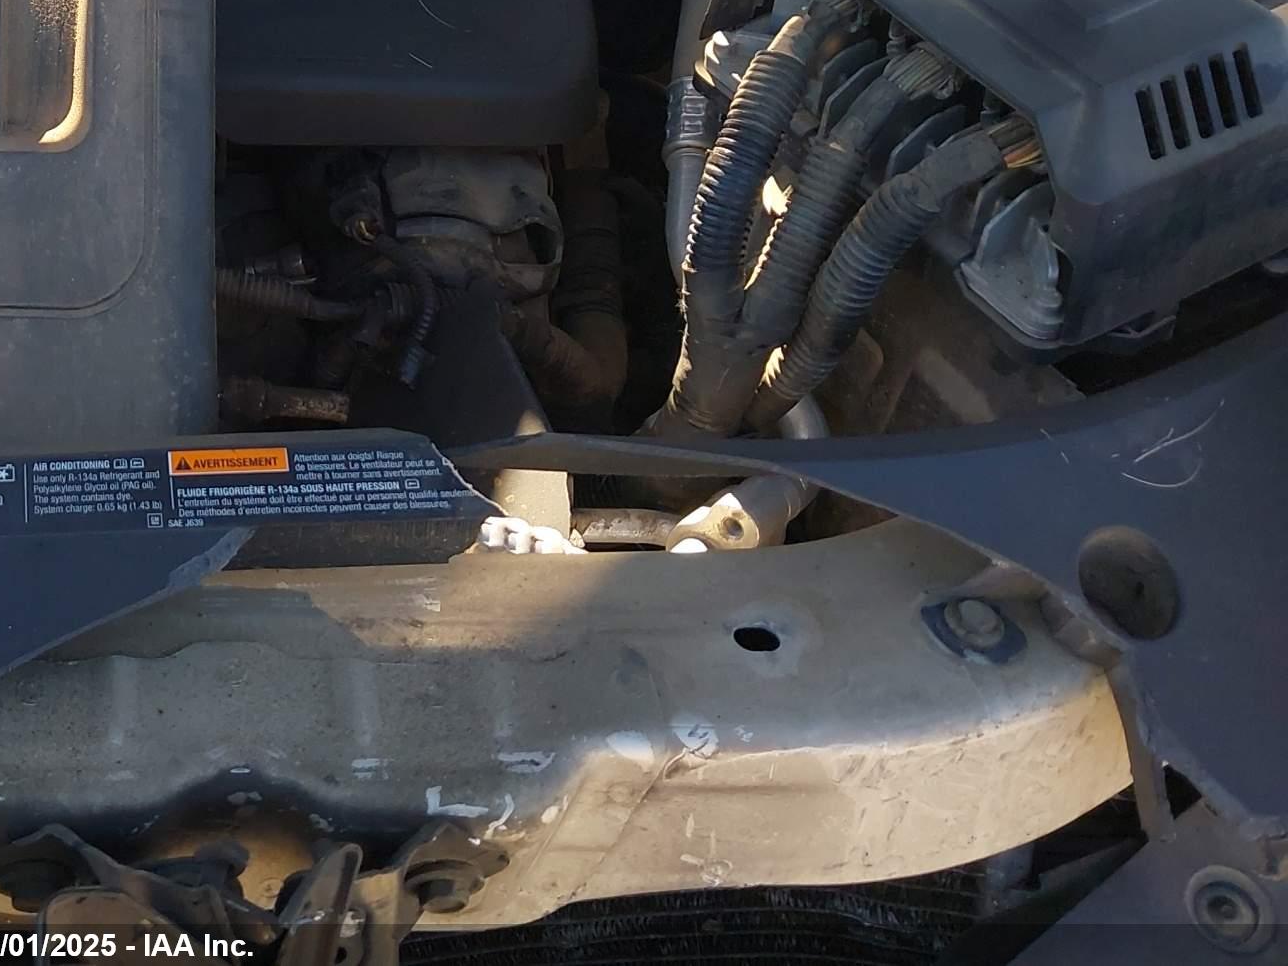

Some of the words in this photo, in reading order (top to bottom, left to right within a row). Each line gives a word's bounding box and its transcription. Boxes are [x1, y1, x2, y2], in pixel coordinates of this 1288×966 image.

[193, 456, 279, 469] AVERTISSEMENT
[294, 453, 330, 462] Attention
[377, 451, 404, 461] Risque
[33, 463, 48, 472] AIR
[50, 460, 110, 471] CONDITIONING
[295, 463, 305, 471] de
[307, 461, 346, 471] blessures.
[349, 461, 359, 470] Le
[362, 460, 403, 469] ventilateur
[406, 459, 423, 468] peut
[33, 474, 48, 483] Use
[50, 474, 66, 483] only
[69, 473, 97, 482] R-134a
[100, 471, 143, 481] Refrigerant
[145, 470, 160, 479] and
[296, 472, 322, 481] mettre
[332, 470, 360, 479] tourner
[33, 484, 82, 493] Polyalkylene
[84, 482, 108, 492] Glycol
[110, 482, 119, 490] oil
[121, 481, 139, 491] (PAG
[177, 487, 207, 498] FLUIDE
[209, 484, 266, 496] FRIGORIGÈNE
[268, 485, 298, 494] R-134a
[301, 484, 324, 493] SOUS
[326, 483, 354, 492] HAUTE
[356, 481, 399, 491] PRESSION
[34, 495, 48, 504] The
[50, 494, 79, 504] system
[81, 493, 114, 502] contains
[222, 498, 232, 506] du
[269, 494, 285, 504] doit
[339, 494, 352, 503] par
[367, 492, 407, 501] personnel
[409, 490, 438, 500] qualifié
[34, 505, 63, 515] System
[97, 502, 115, 512] 0.65
[117, 502, 127, 512] kg
[152, 500, 162, 510] lb)
[179, 508, 194, 517] Des
[196, 506, 236, 516] méthodes
[283, 503, 327, 513] incorrectes
[329, 502, 361, 512] peuvent
[363, 502, 391, 510] causer
[393, 501, 408, 510] des
[168, 519, 183, 528] SAE
[185, 518, 204, 527] J639
